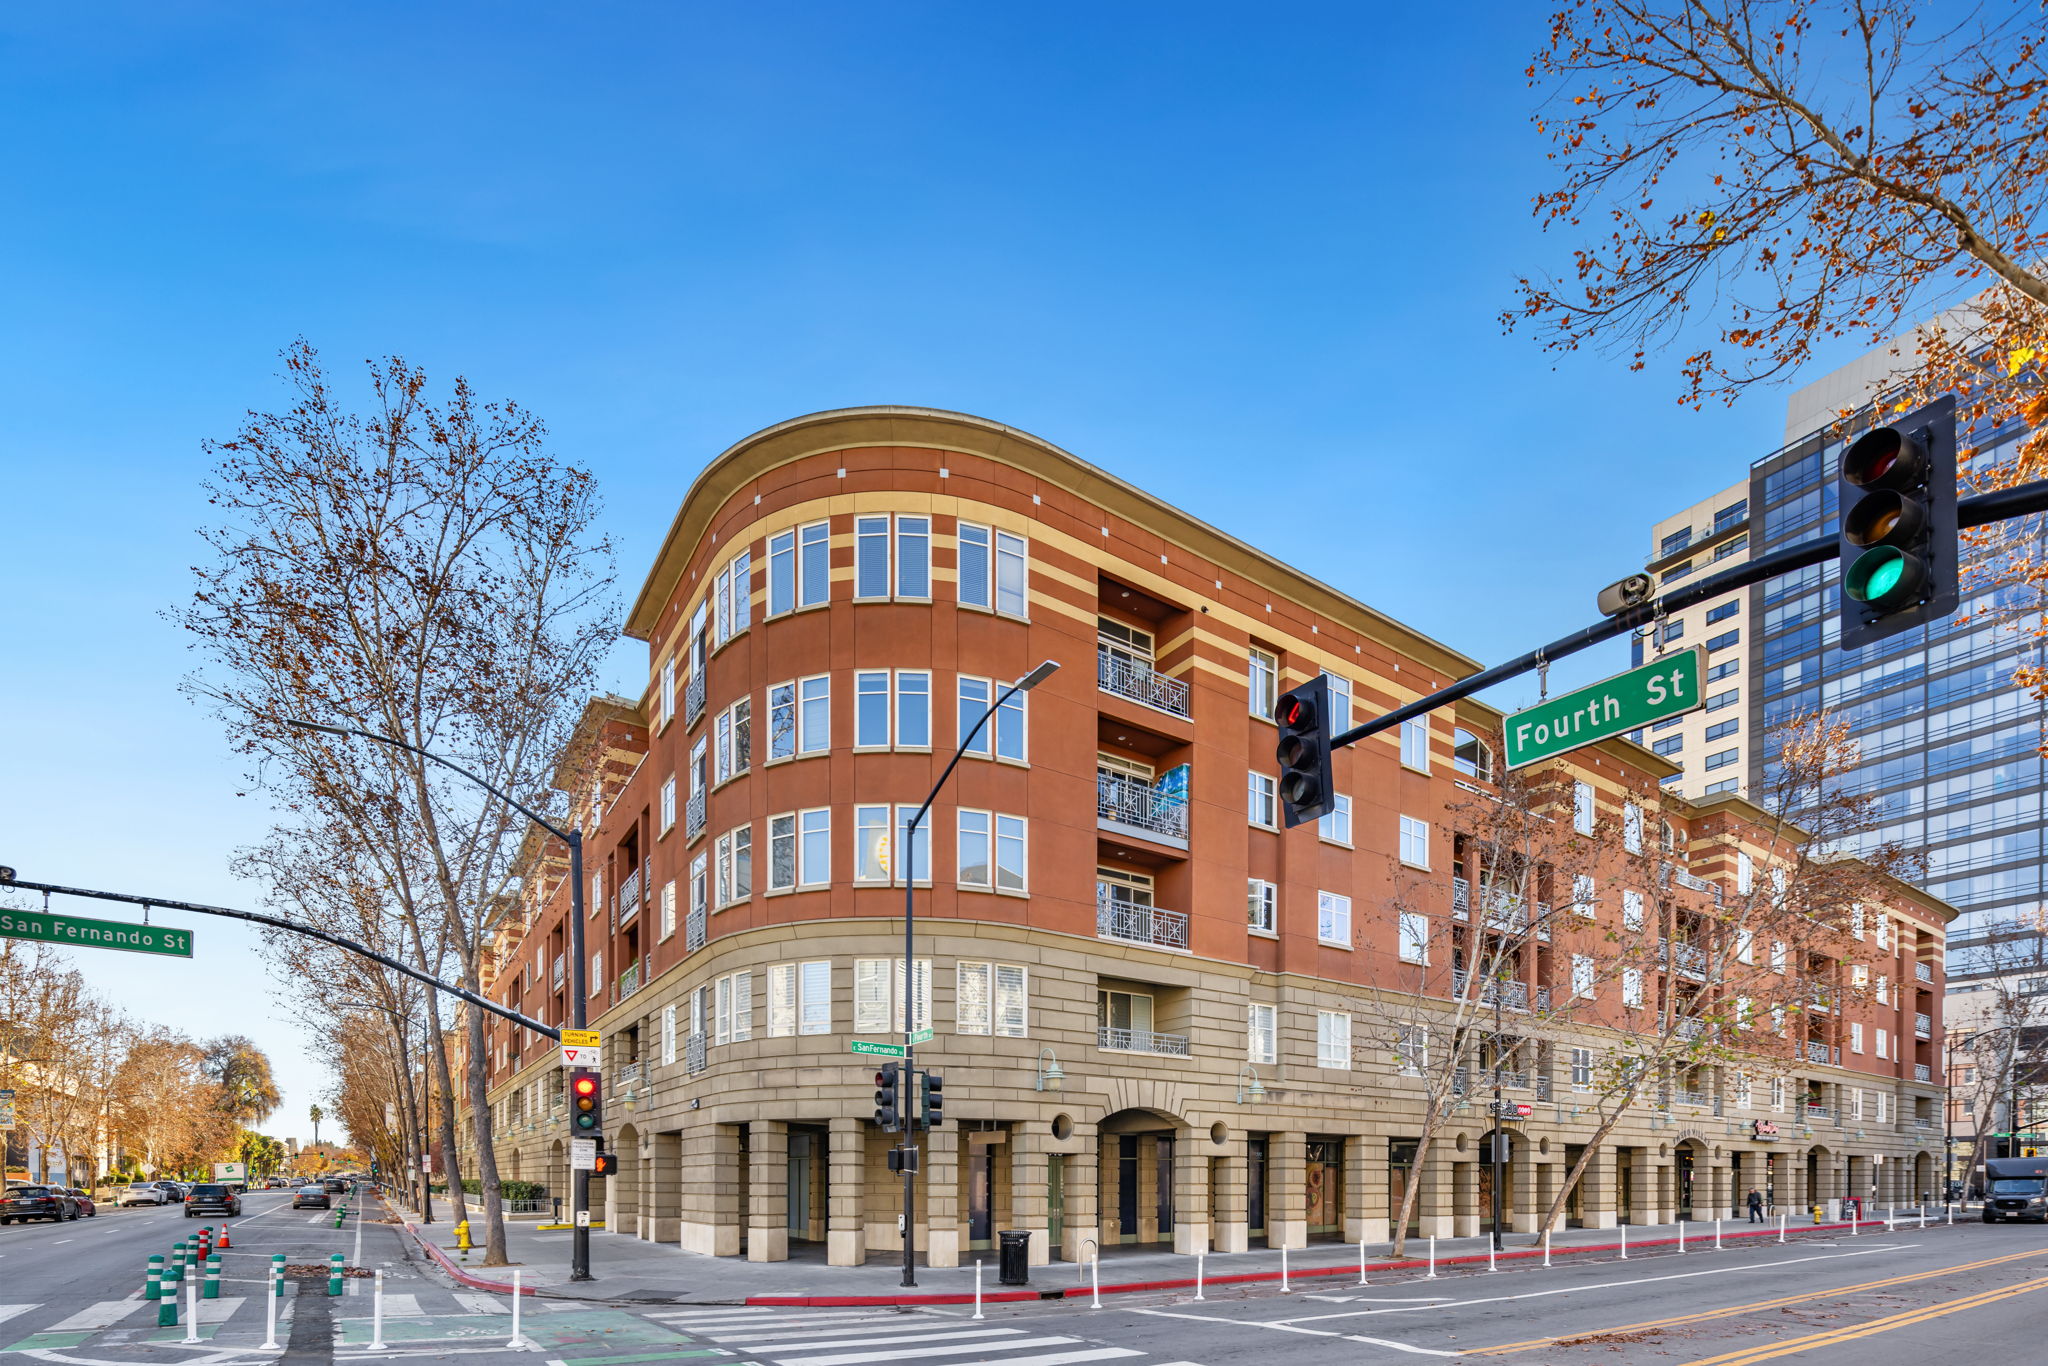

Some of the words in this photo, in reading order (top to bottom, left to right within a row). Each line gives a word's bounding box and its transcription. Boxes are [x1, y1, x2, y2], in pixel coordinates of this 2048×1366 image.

[1516, 694, 1620, 752] Fourth
[1646, 668, 1684, 705] St
[1, 915, 43, 934] San
[54, 922, 153, 946] Fernando
[163, 934, 185, 950] St
